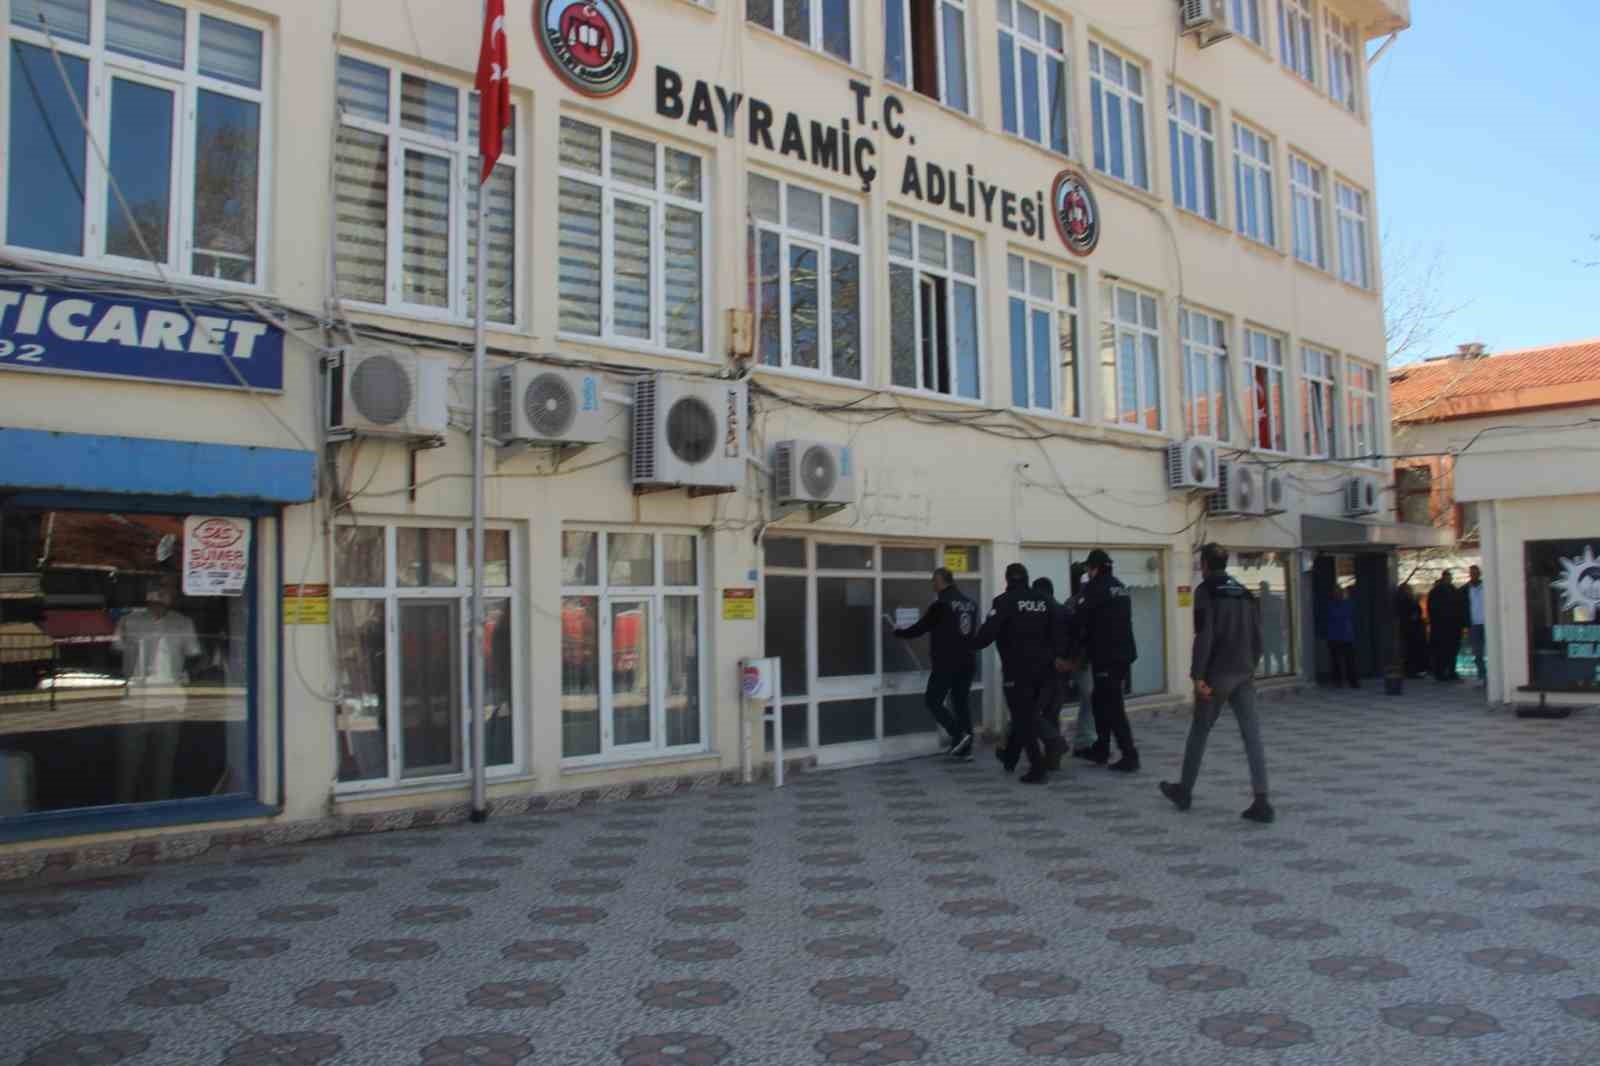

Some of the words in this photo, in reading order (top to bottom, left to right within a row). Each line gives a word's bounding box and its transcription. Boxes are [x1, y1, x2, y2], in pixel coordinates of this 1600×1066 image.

[656, 65, 877, 193] BAYRAMİÇ
[901, 155, 1045, 241] ADLİYESİ
[849, 79, 915, 145] T.C.
